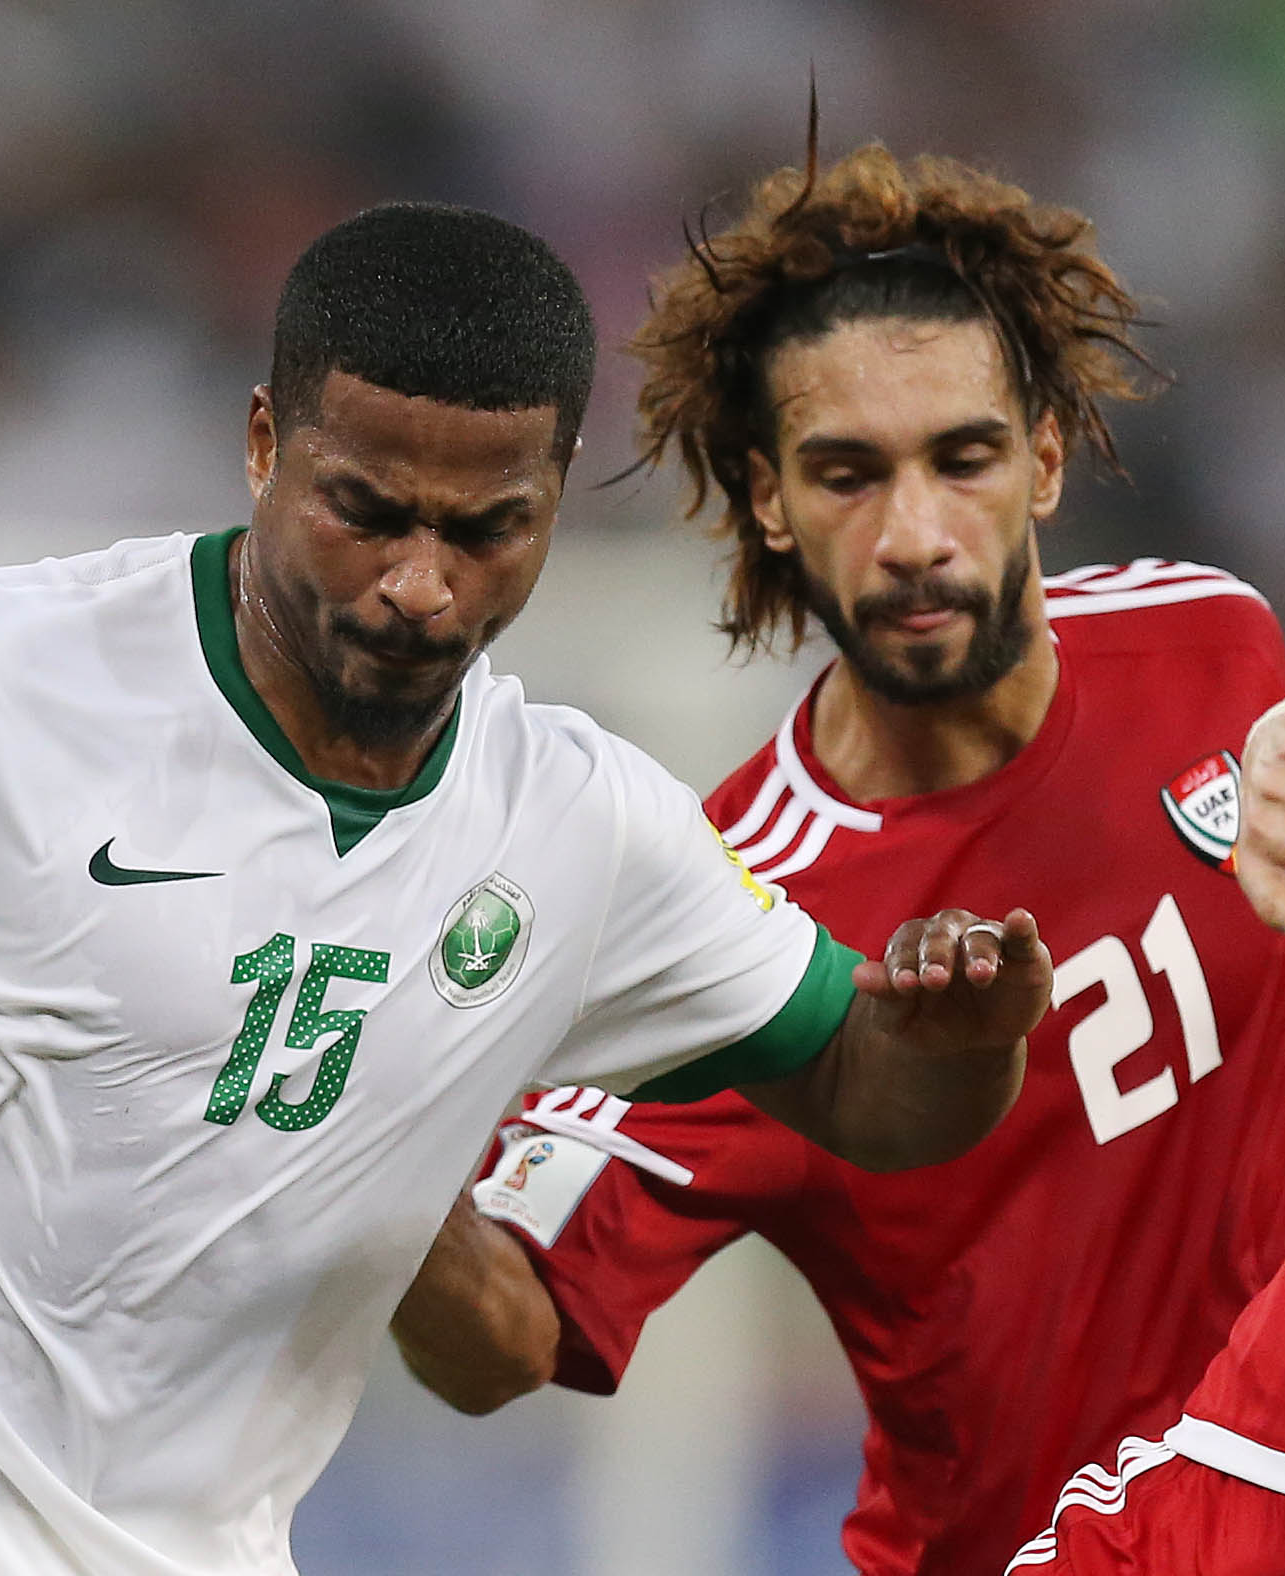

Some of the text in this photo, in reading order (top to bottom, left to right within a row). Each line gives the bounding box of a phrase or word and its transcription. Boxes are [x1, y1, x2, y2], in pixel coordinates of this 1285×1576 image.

[1196, 788, 1234, 817] UAE
[1214, 811, 1234, 828] FA
[203, 933, 391, 1131] 15
[1051, 893, 1224, 1146] 21
